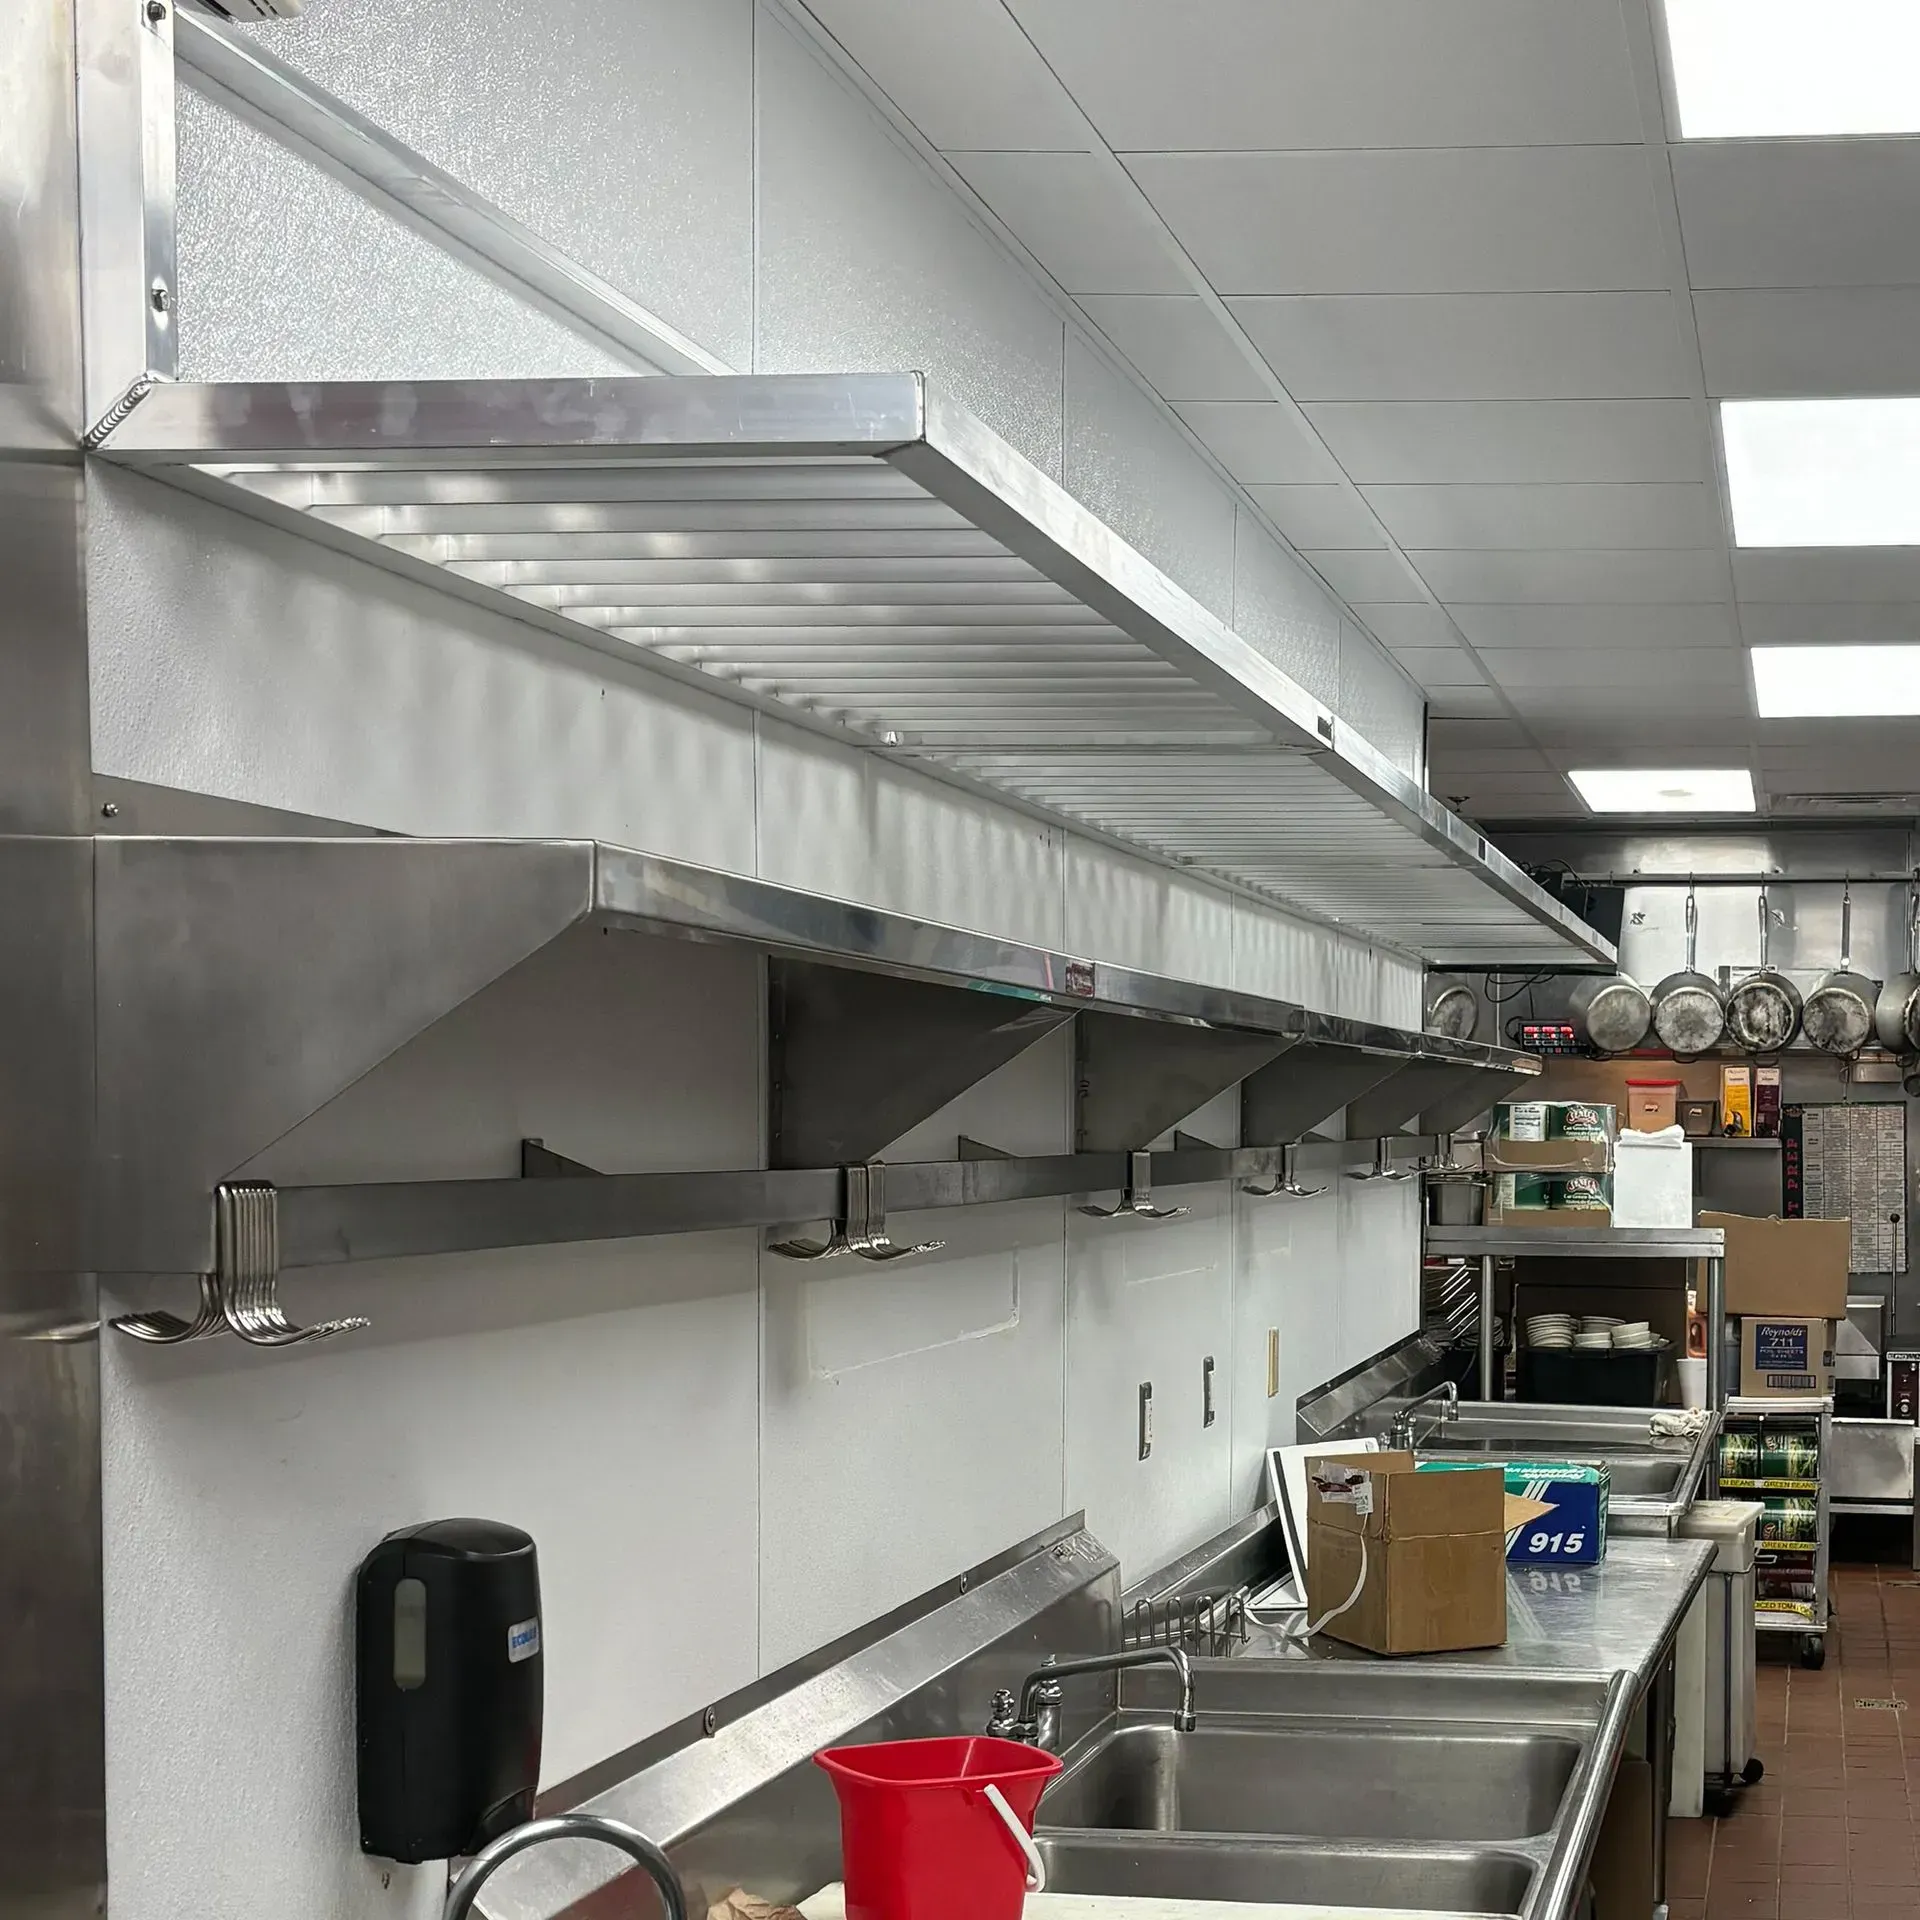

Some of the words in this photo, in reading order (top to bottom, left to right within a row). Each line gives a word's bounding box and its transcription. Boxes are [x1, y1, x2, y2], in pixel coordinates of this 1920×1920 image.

[1787, 1138, 1799, 1190] PREP
[1761, 1327, 1803, 1337] Reynolds
[1769, 1338, 1793, 1346] 711
[1528, 1533, 1585, 1553] 915
